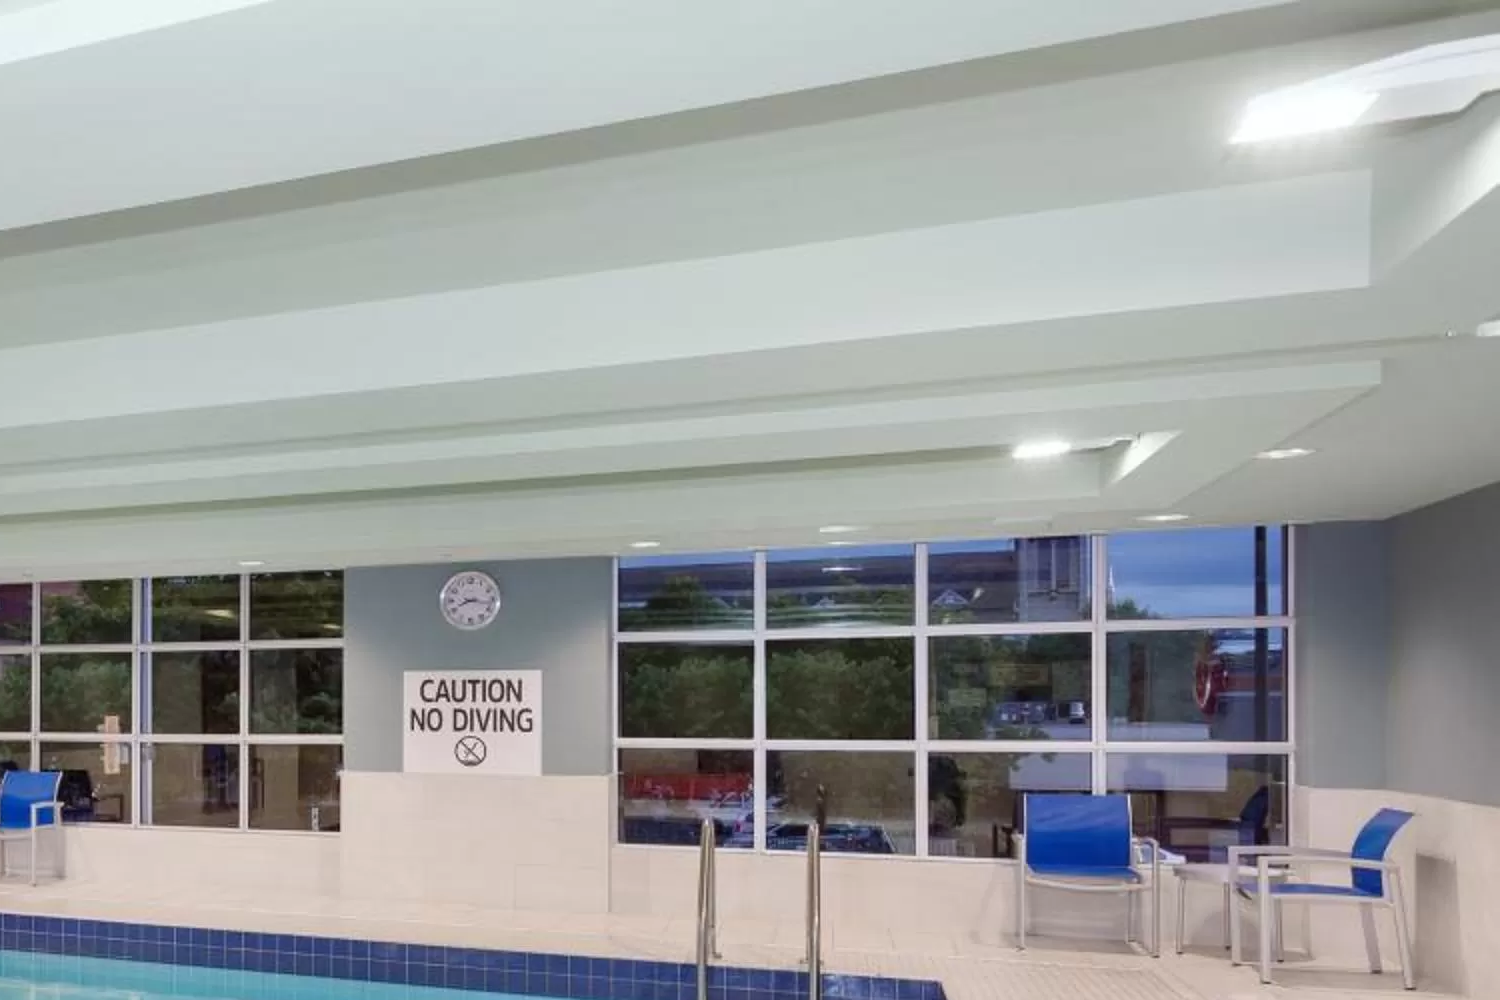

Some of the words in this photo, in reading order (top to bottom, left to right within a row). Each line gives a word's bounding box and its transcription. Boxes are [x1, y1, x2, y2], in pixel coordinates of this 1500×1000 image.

[419, 679, 523, 702] CAUTION
[410, 708, 443, 731] NO
[453, 708, 533, 732] DIVING
